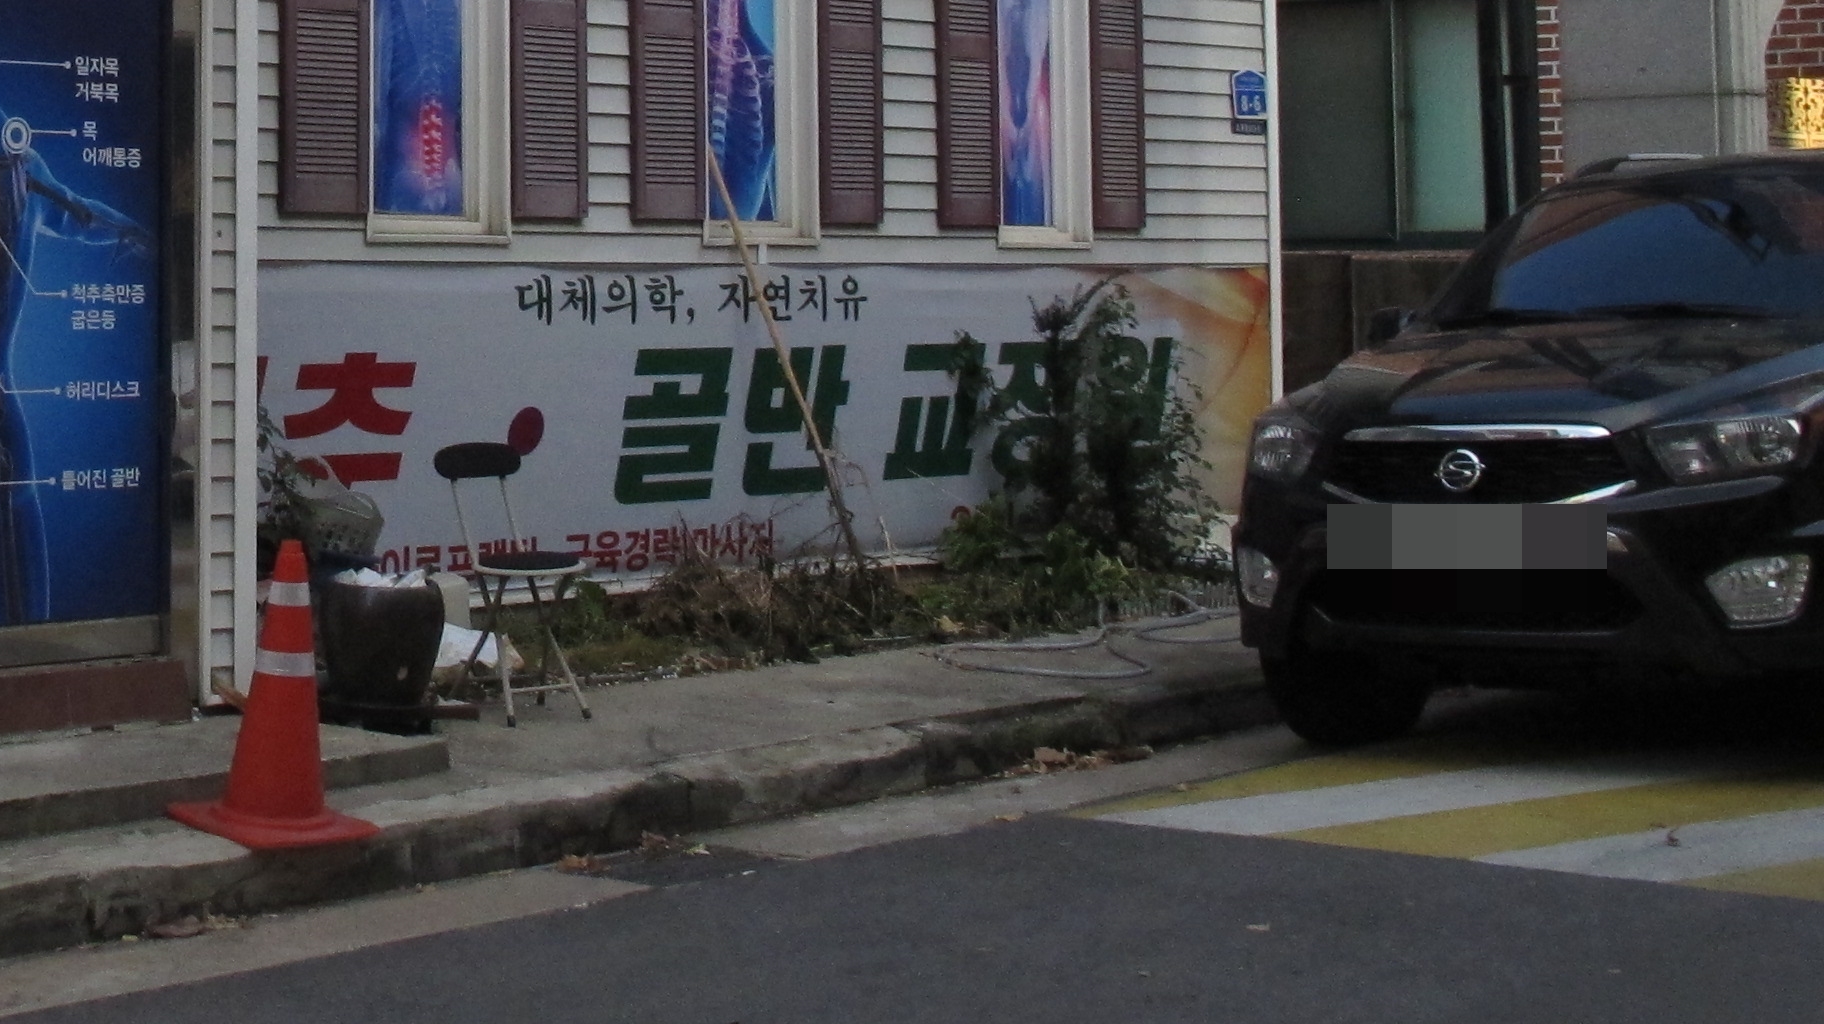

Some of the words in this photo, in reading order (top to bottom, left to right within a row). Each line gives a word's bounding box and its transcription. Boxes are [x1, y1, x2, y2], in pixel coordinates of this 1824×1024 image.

[75, 56, 119, 77] 일자목
[75, 81, 119, 103] 거북목
[82, 121, 97, 141] 목
[82, 147, 142, 168] 어깨통증
[71, 284, 146, 304] 척추측만증
[514, 274, 696, 325] 대체의학,
[718, 274, 869, 322] 자연치유
[71, 309, 116, 330] 굽은등
[66, 381, 140, 400] 허리디스크
[257, 351, 418, 491] 추
[61, 469, 107, 490] 틀어진
[110, 466, 140, 487] 골반
